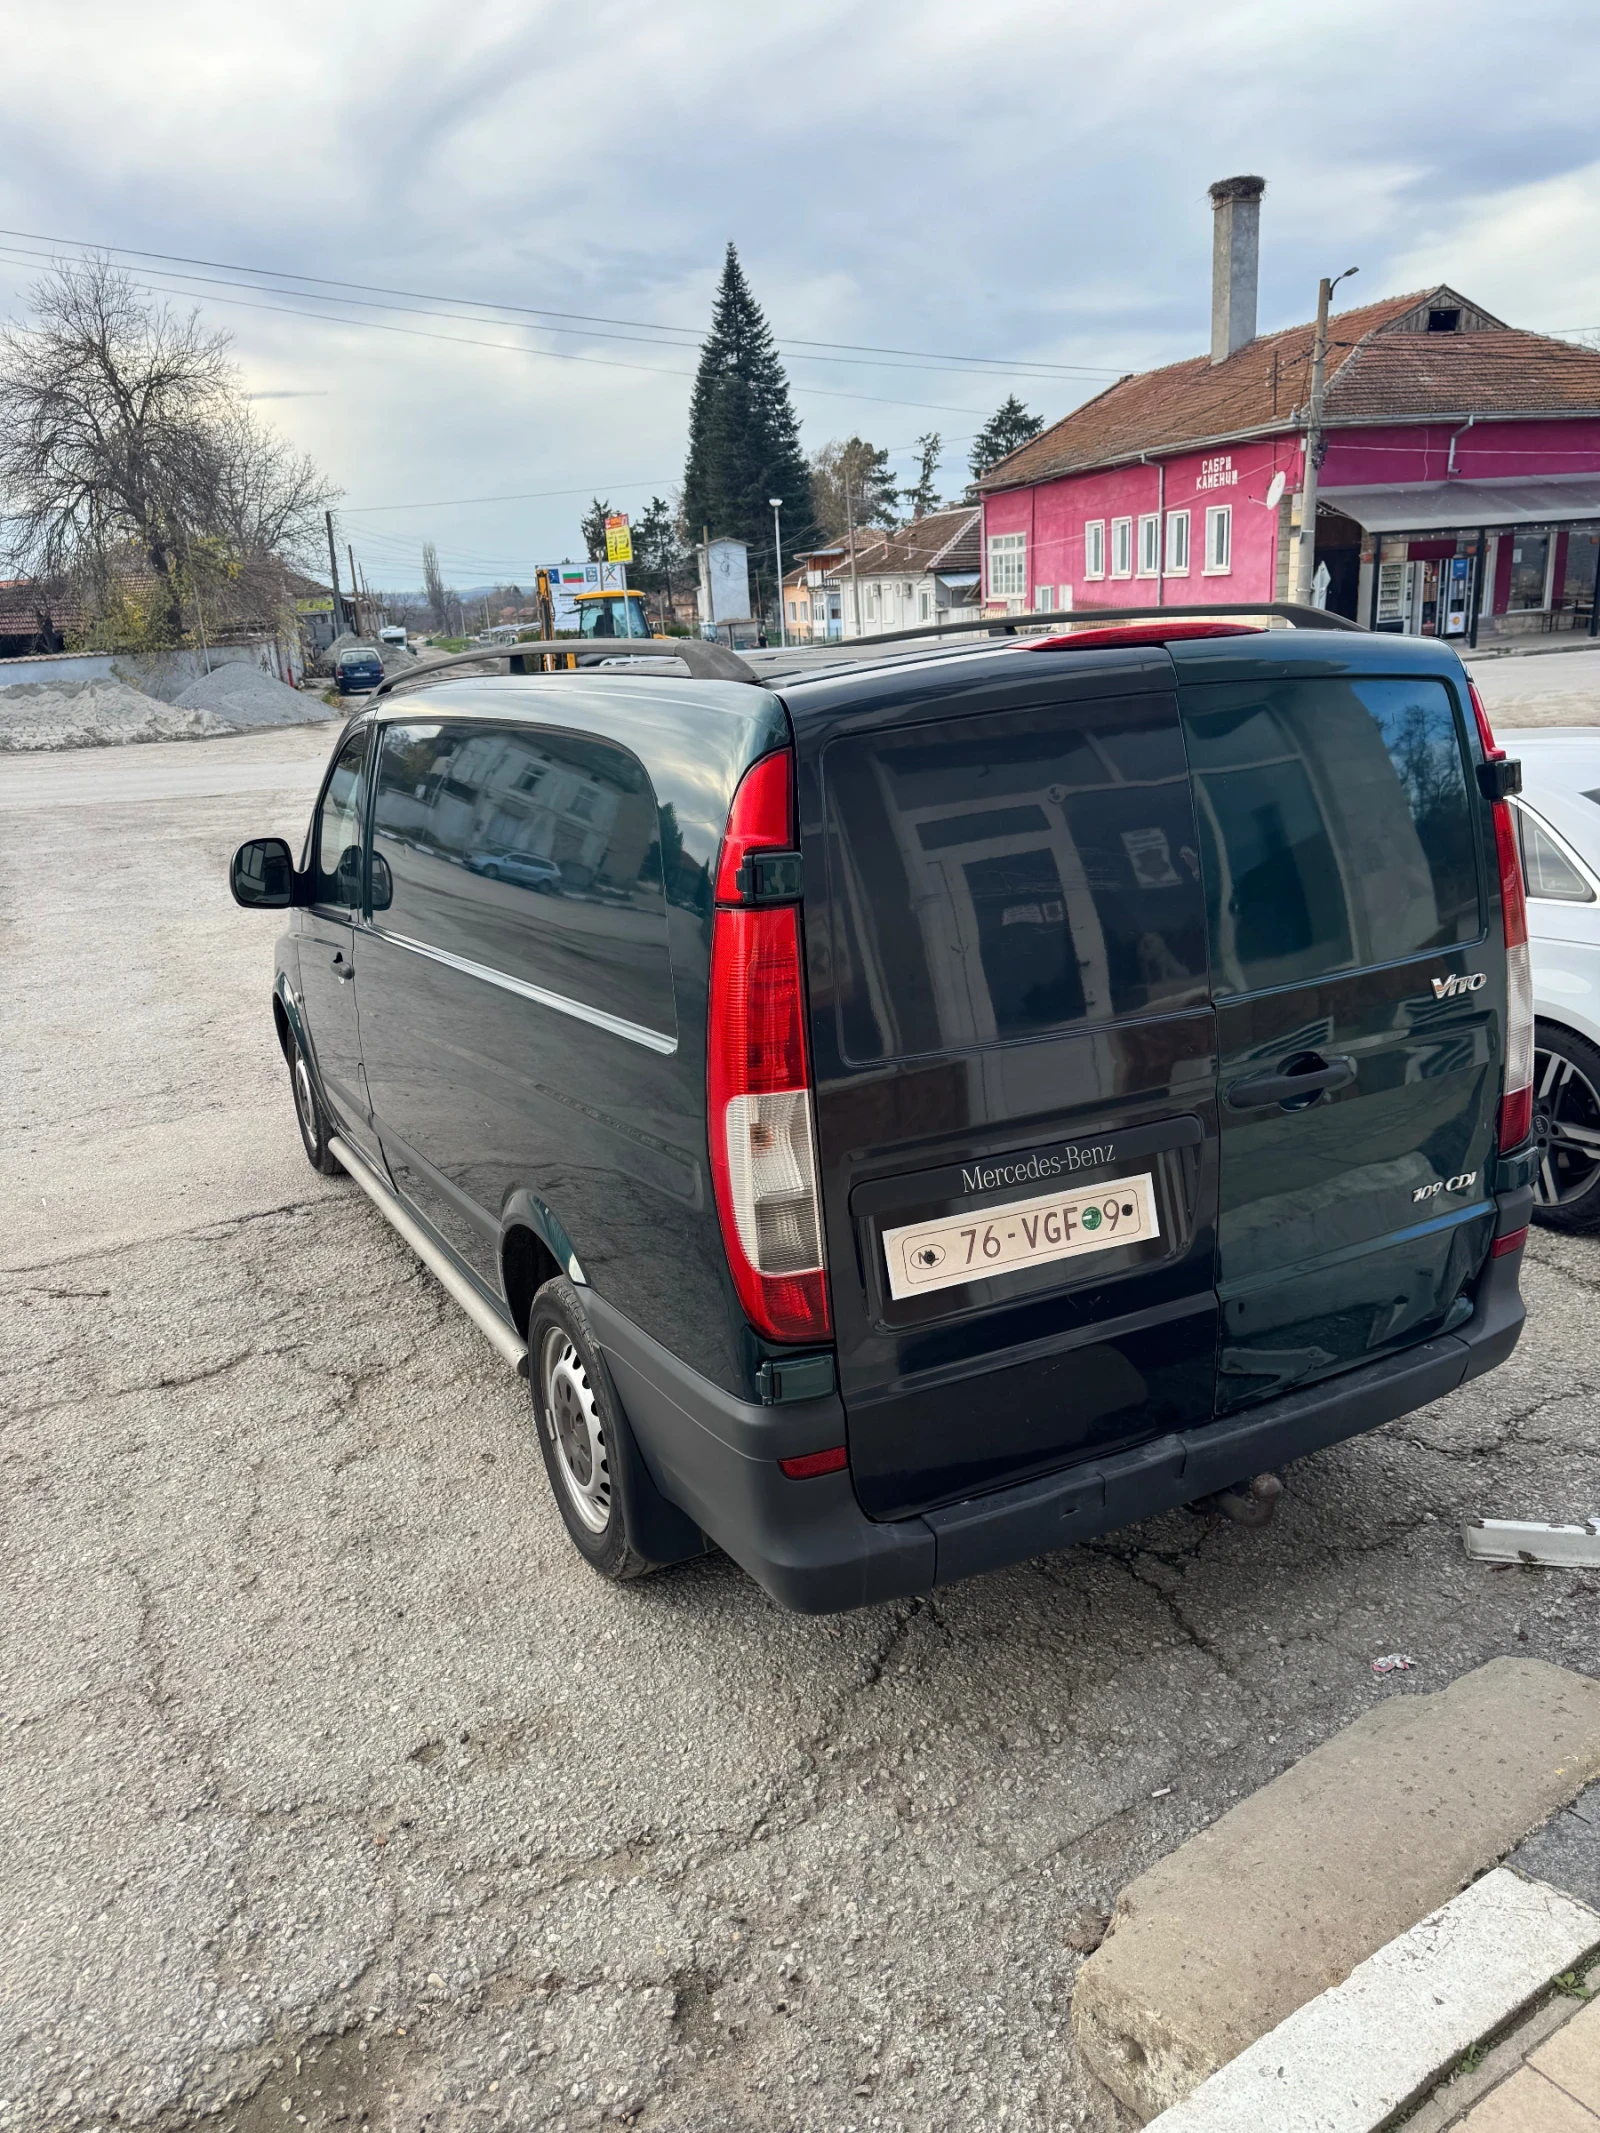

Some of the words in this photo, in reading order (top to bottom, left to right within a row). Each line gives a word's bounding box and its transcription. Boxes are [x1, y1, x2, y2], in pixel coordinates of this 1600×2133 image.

[1202, 456, 1232, 474] САБРИ
[961, 1144, 1116, 1193] Mercedes-Benz
[1412, 1181, 1444, 1203] 109
[1445, 1171, 1477, 1192] CDI
